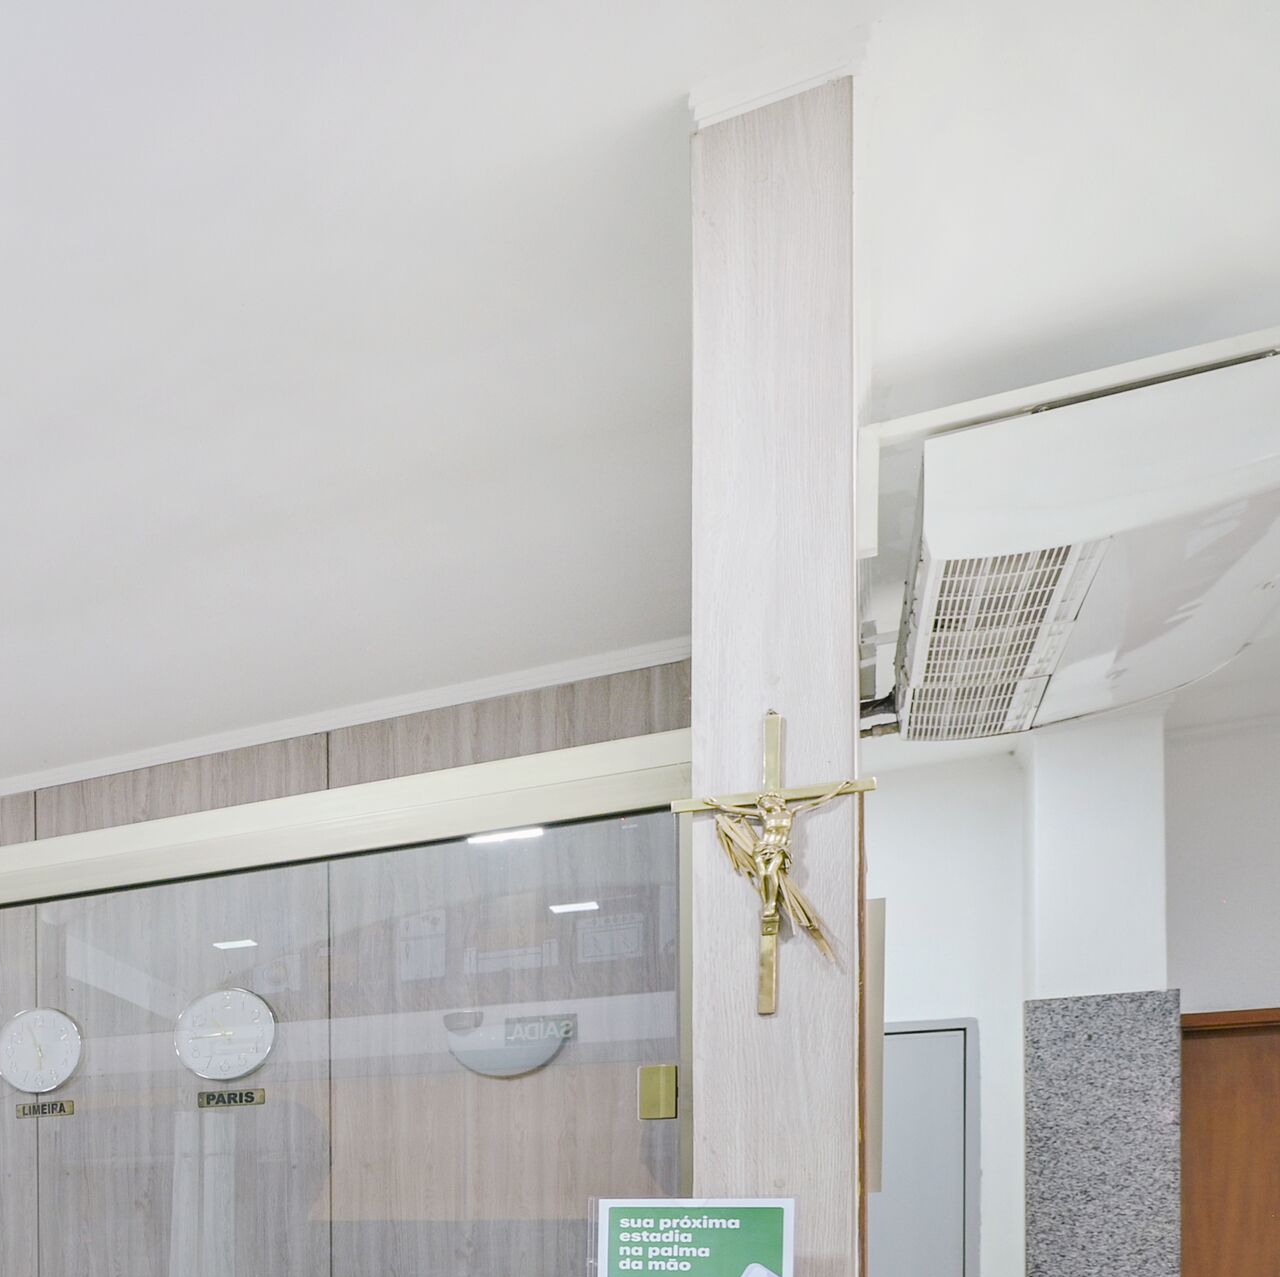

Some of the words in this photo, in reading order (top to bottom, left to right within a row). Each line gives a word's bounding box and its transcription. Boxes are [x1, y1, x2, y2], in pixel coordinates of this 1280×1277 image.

[206, 1091, 255, 1105] PARIS
[22, 1103, 66, 1116] LIMEIRA
[620, 1218, 654, 1228] sua
[660, 1215, 740, 1231] próxima
[619, 1229, 693, 1243] estadia
[619, 1246, 643, 1256] na
[648, 1244, 710, 1259] palma
[618, 1258, 643, 1270] da
[648, 1259, 691, 1271] mão
